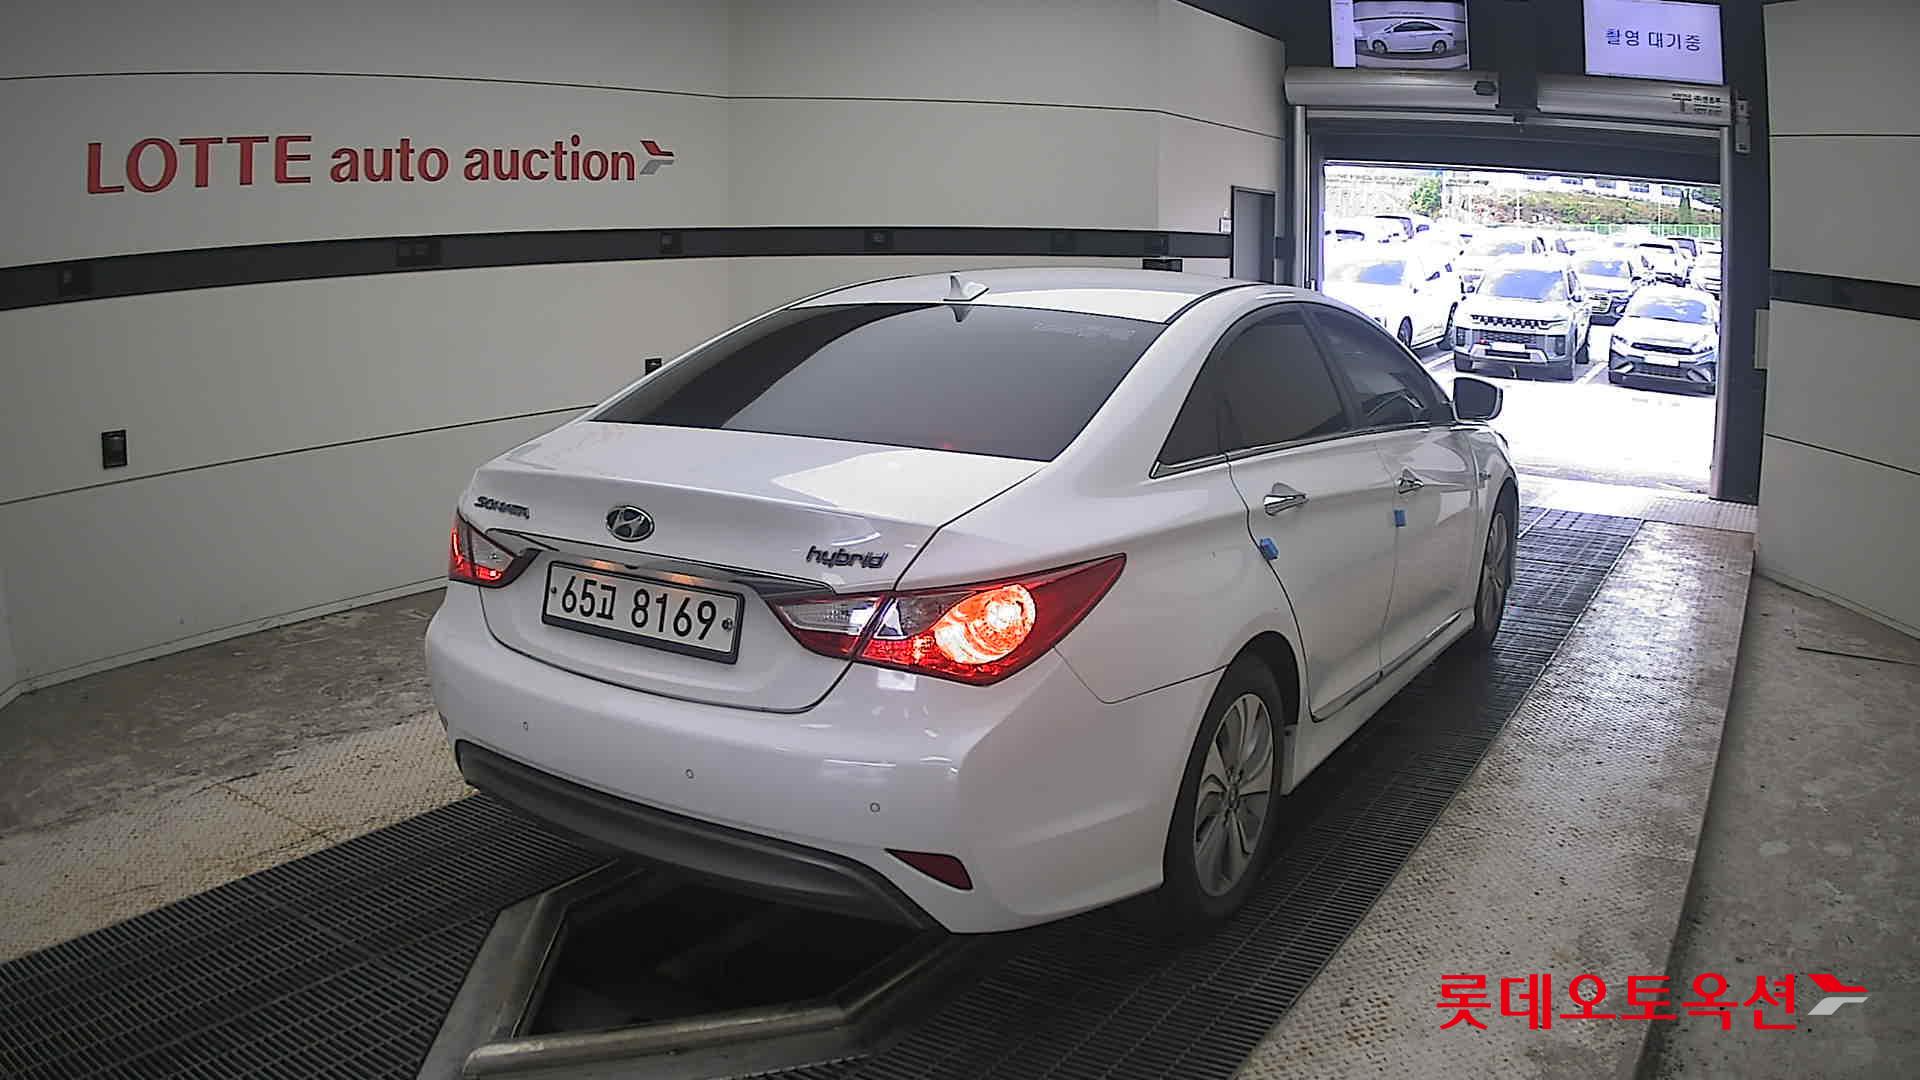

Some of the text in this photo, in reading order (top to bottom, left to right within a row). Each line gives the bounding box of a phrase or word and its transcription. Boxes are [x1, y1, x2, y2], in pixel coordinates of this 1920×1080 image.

[1648, 31, 1702, 52] 대기중
[87, 135, 636, 195] LOTTE auto auction
[806, 545, 888, 569] hybrid
[562, 575, 717, 641] 65고 8169
